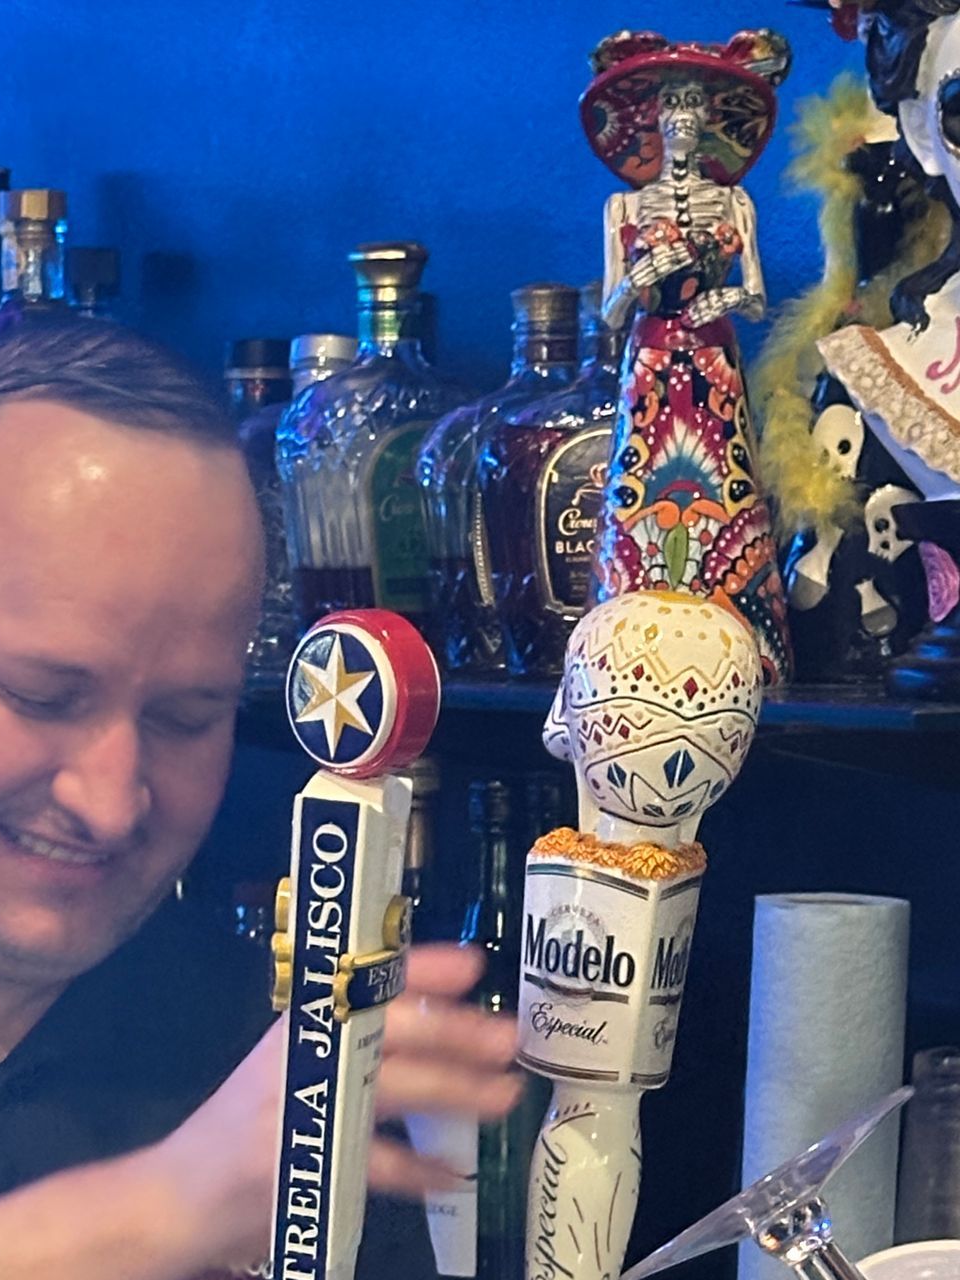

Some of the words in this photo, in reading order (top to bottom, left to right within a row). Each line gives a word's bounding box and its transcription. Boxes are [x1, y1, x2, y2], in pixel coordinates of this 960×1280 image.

[555, 540, 596, 554] BLAC
[298, 822, 348, 1060] JALISCO
[524, 914, 635, 988] Modelo
[530, 1002, 607, 1045] Especial
